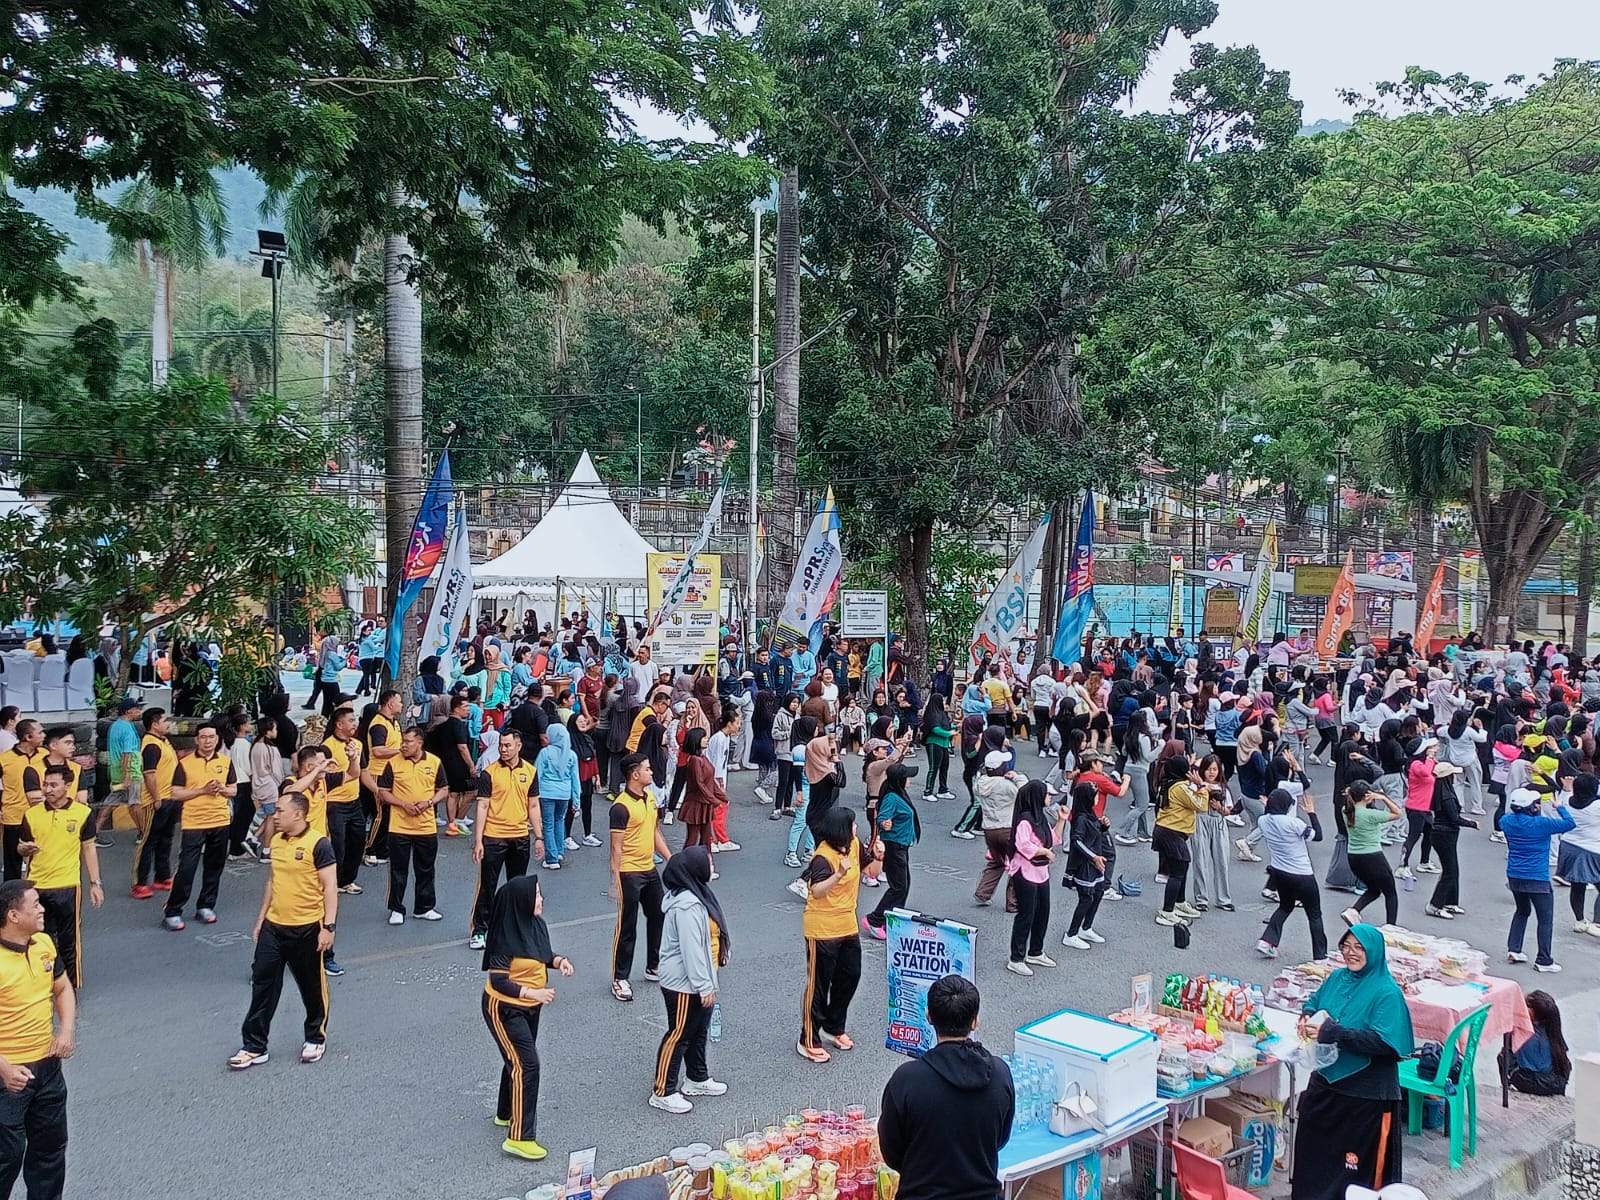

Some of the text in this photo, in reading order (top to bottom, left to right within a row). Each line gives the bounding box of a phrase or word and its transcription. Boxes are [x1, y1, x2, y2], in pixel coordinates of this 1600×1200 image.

[996, 586, 1025, 633] BSI
[899, 937, 946, 957] WATER
[893, 951, 950, 973] STATION
[898, 1028, 919, 1041] 5.000
